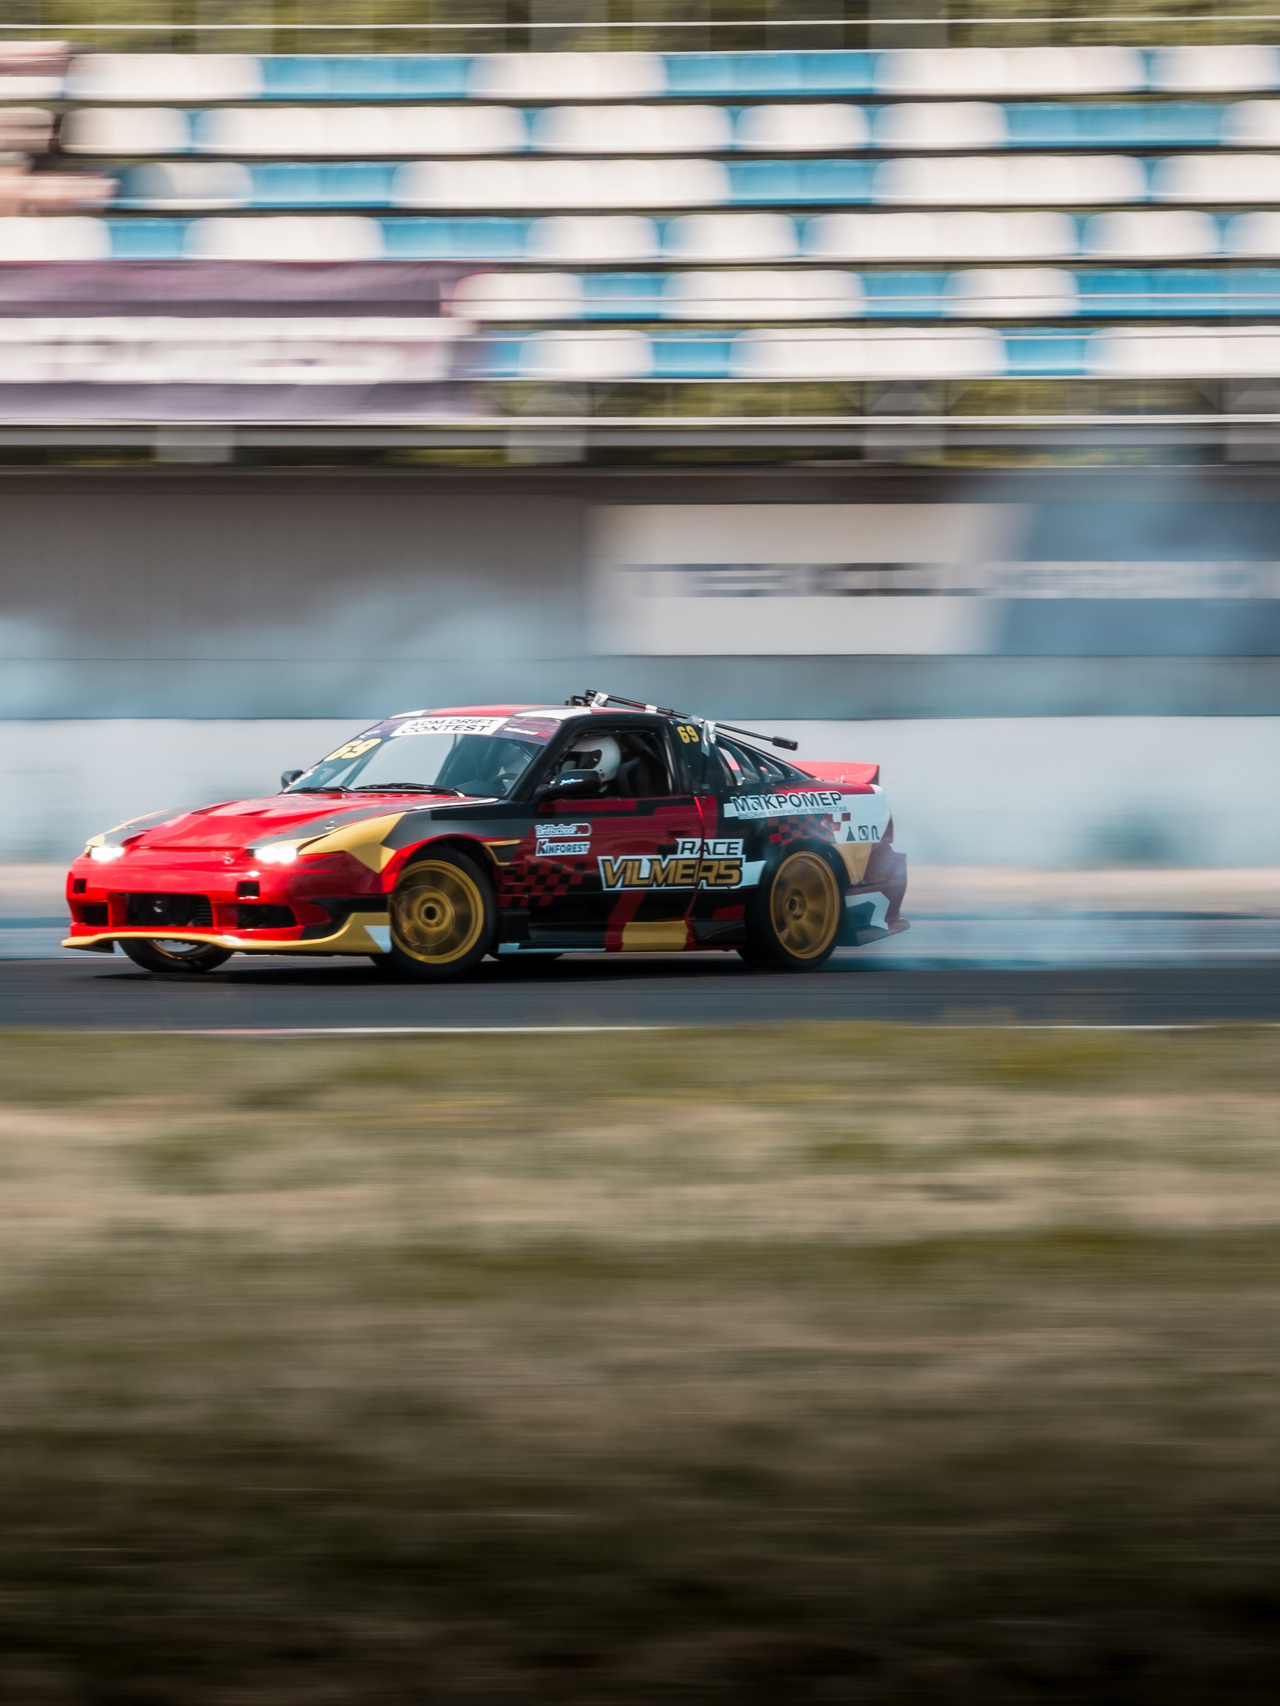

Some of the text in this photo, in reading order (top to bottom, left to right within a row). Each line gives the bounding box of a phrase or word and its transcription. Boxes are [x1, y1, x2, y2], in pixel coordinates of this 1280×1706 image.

[401, 725, 491, 734] CONTEST
[676, 725, 700, 744] 69
[323, 737, 382, 762] 69
[537, 840, 588, 855] KINFOREST
[680, 841, 739, 856] RACE
[601, 858, 743, 888] VILMERS
